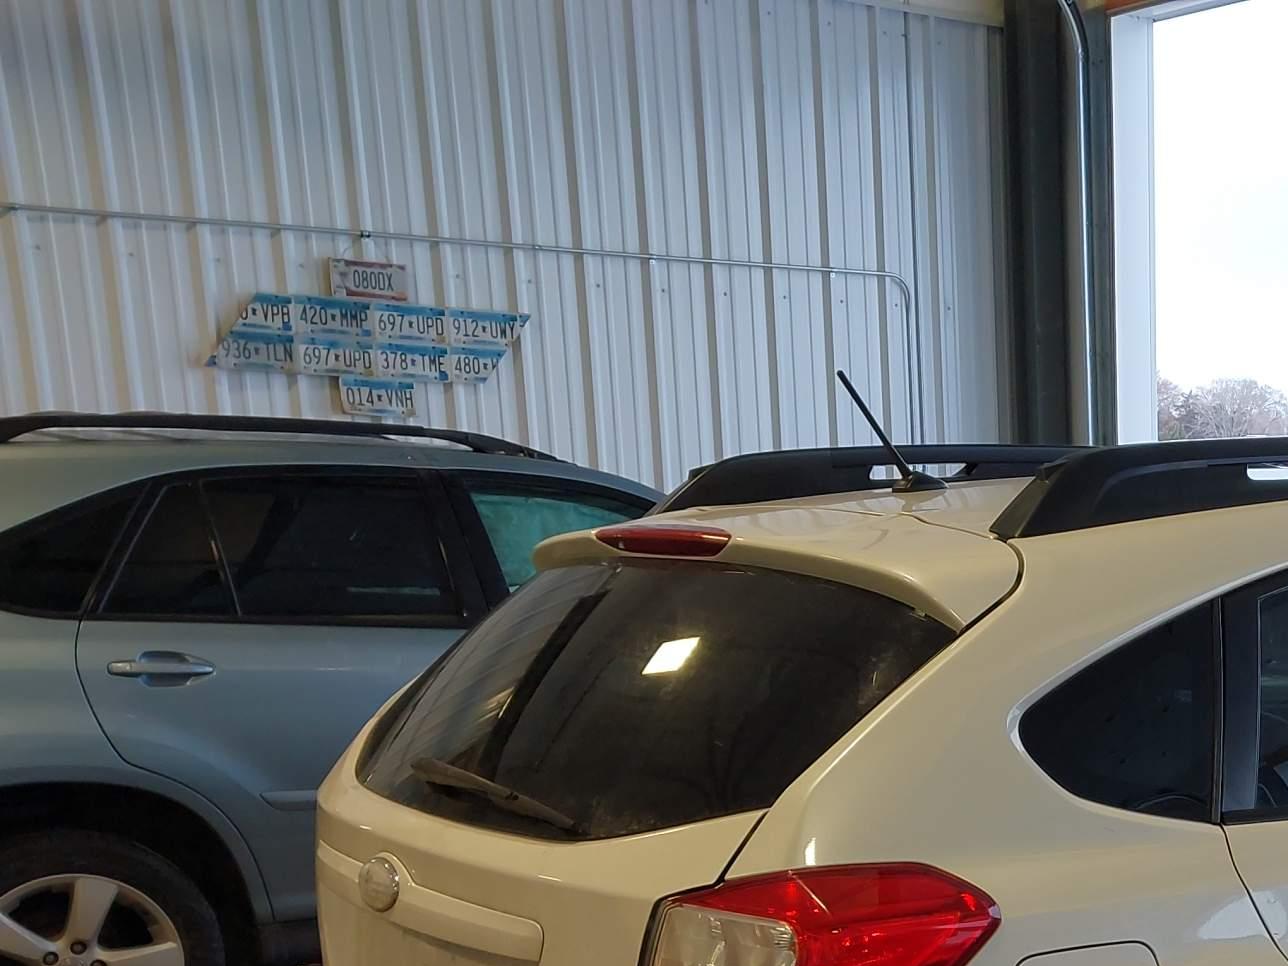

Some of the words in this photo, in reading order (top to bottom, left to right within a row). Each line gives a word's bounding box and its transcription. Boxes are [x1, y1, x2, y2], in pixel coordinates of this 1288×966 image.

[299, 305, 328, 326] 420
[377, 313, 405, 333] 697
[452, 318, 480, 338] 912
[303, 346, 331, 366] 697
[380, 351, 408, 371] 378
[419, 353, 446, 373] TME
[454, 356, 481, 375] 480
[346, 387, 374, 406] 014
[385, 388, 414, 408] VNH
